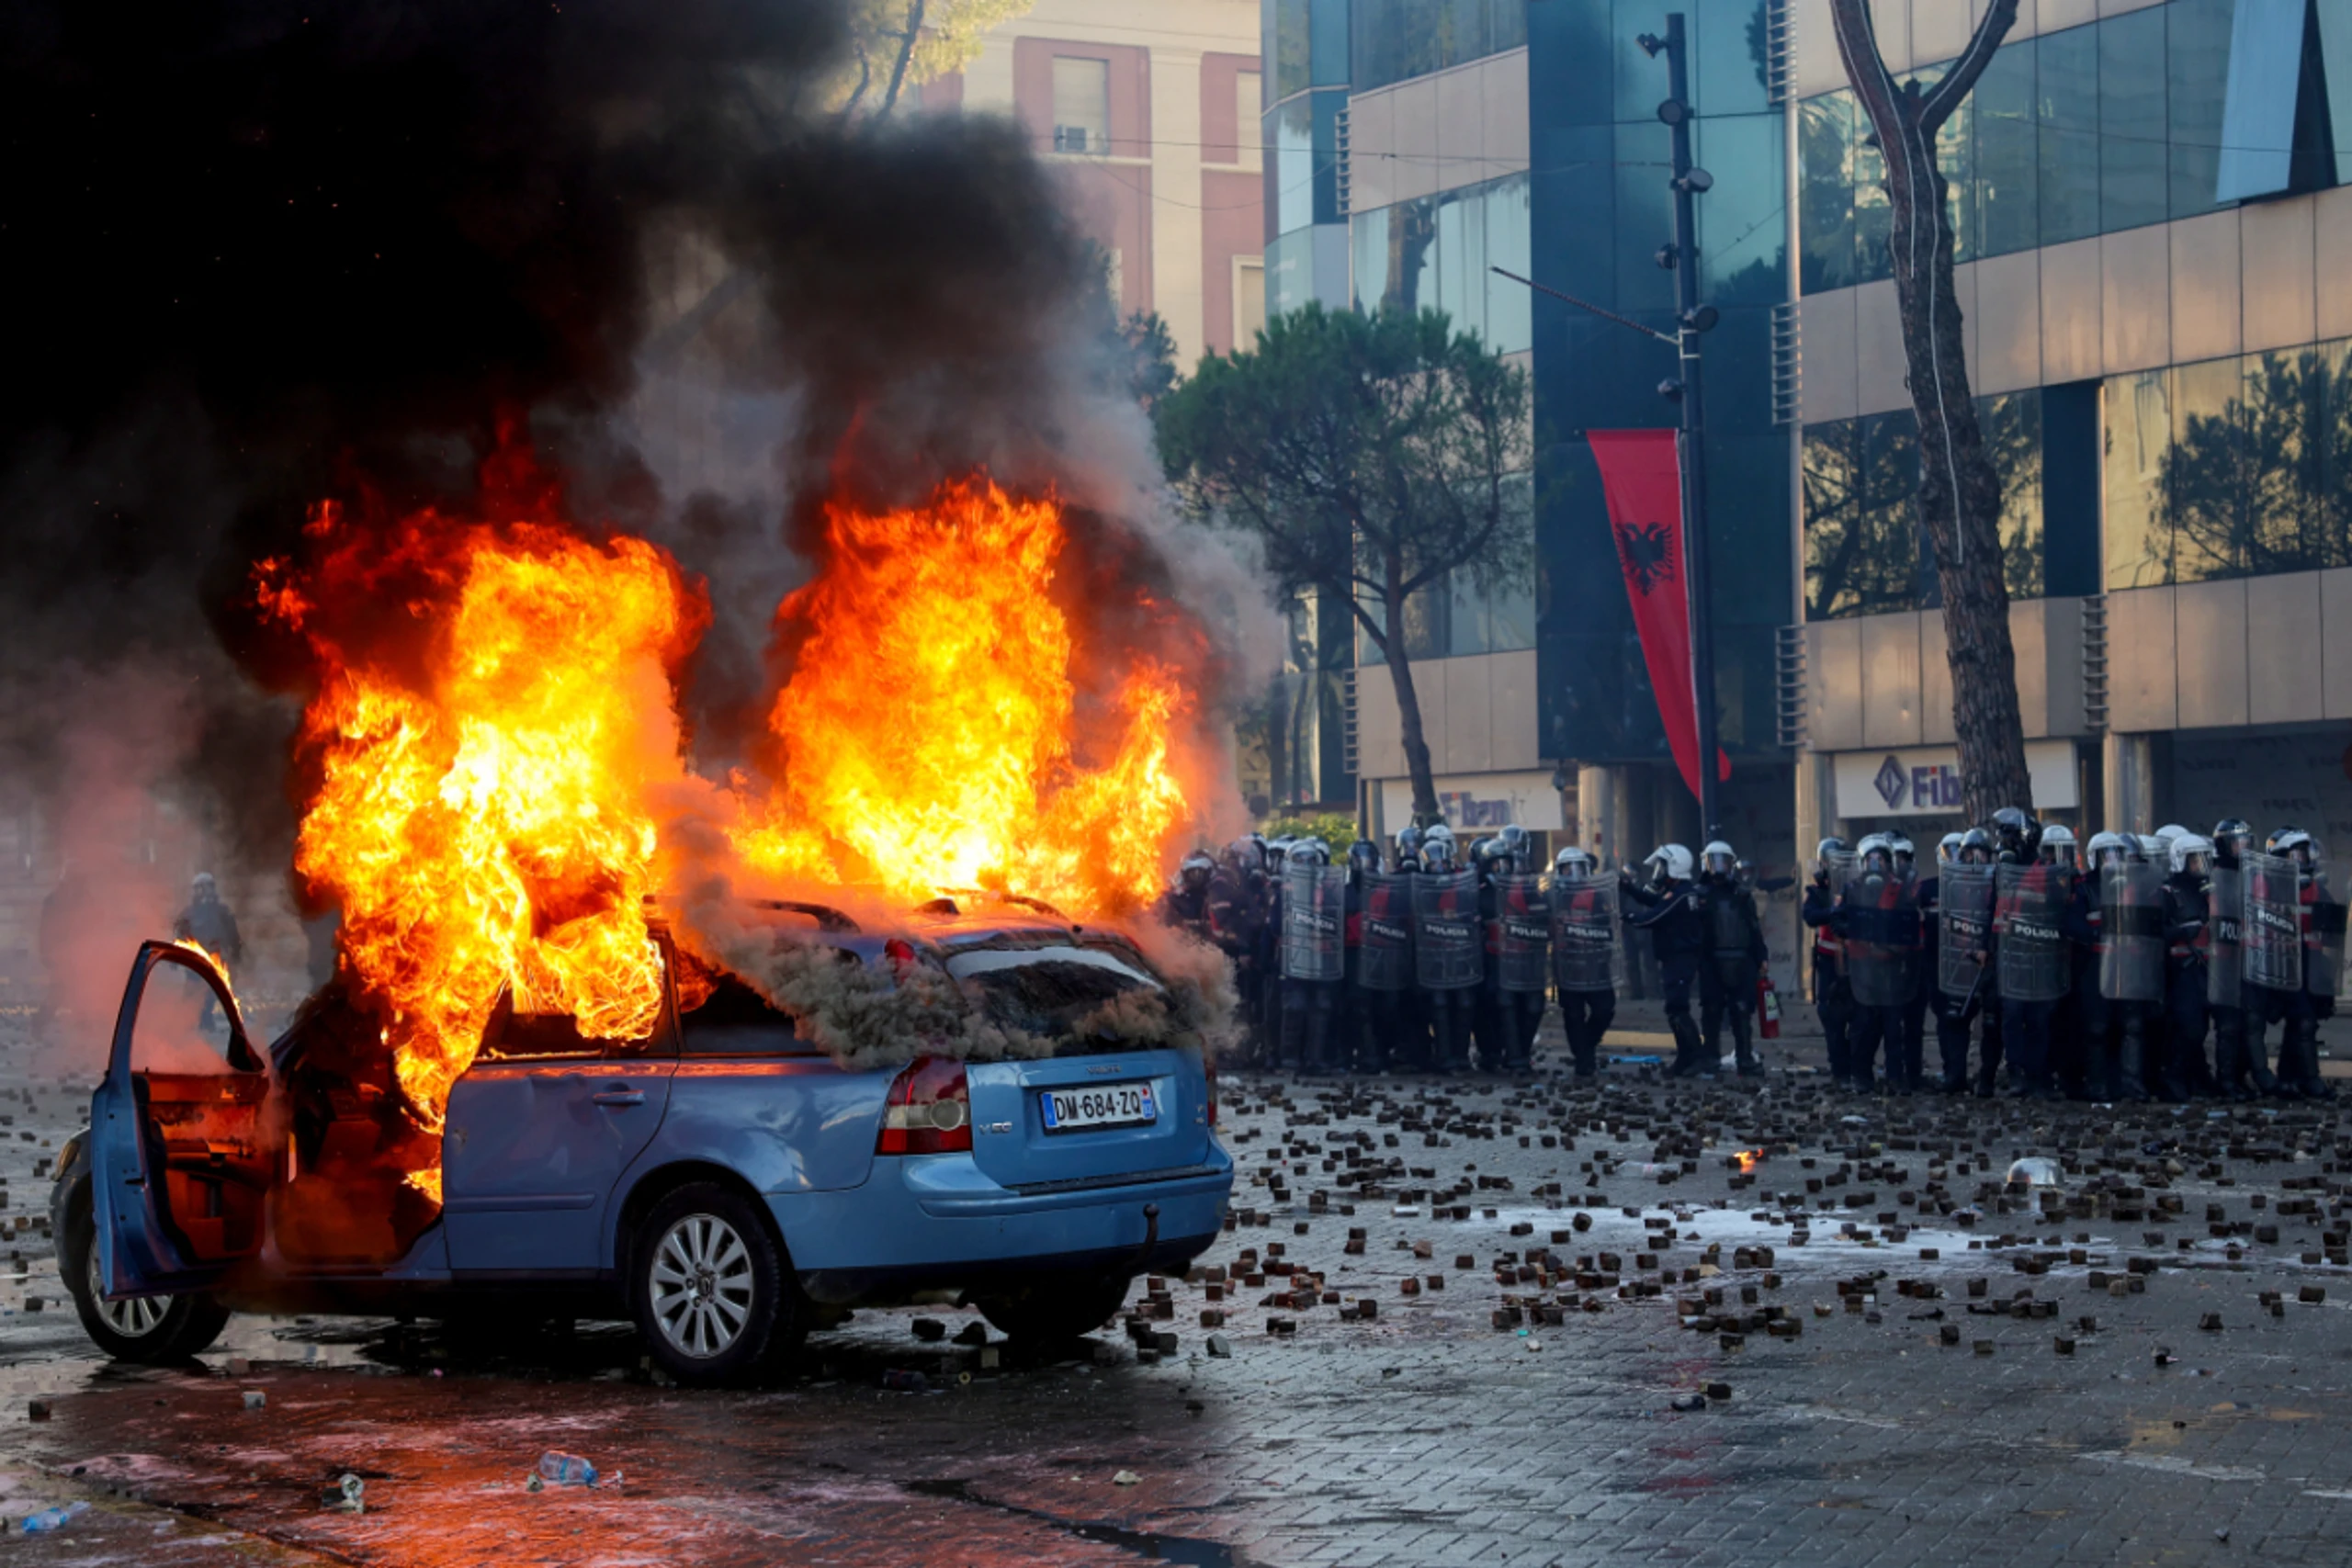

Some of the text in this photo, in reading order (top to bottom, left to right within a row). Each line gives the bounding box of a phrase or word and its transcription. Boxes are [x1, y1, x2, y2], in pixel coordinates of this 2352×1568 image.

[1911, 762, 1961, 807] Fib
[1425, 923, 1469, 937] POLICIA
[1510, 925, 1549, 938] POLICIA
[1566, 926, 1609, 939] POLICIA
[2015, 923, 2060, 939] POLICIA
[1054, 1090, 1142, 1121] DM-684-ZQ
